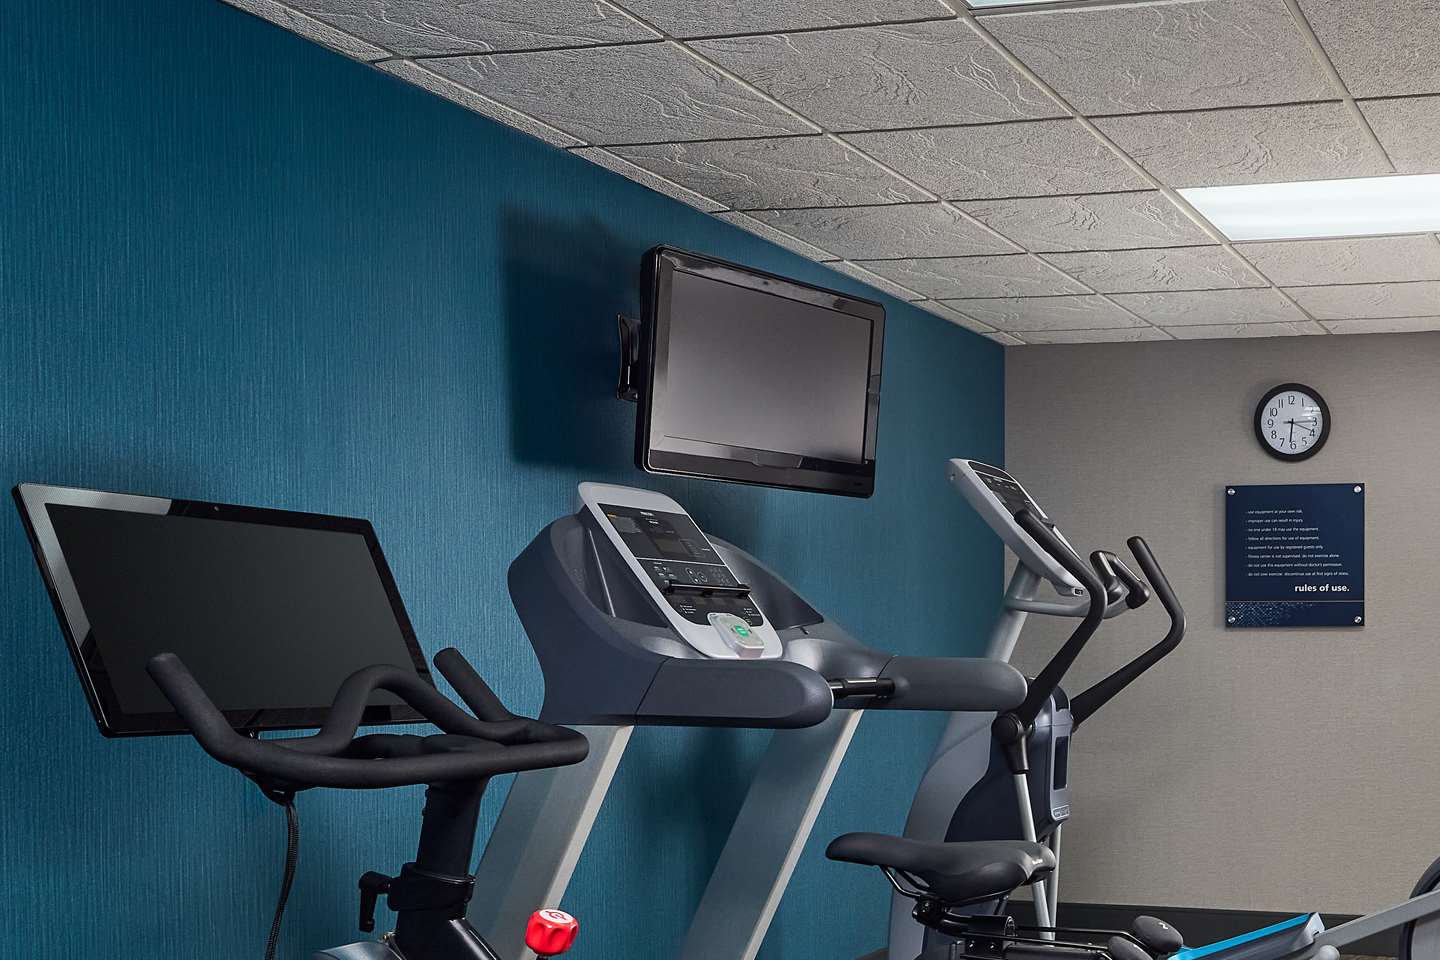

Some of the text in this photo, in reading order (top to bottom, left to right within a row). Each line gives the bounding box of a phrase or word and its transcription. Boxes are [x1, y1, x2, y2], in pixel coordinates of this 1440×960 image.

[1278, 399, 1284, 408] 11
[1288, 395, 1295, 405] 12
[1269, 407, 1278, 417] 10
[1267, 418, 1274, 429] 9
[1312, 417, 1318, 426] 3
[1271, 430, 1277, 439] 8
[1309, 428, 1315, 437] 4
[1279, 437, 1285, 447] 7
[1290, 440, 1297, 450] 6
[1301, 436, 1308, 446] 5
[1294, 584, 1317, 592] rules
[1319, 583, 1330, 592] of
